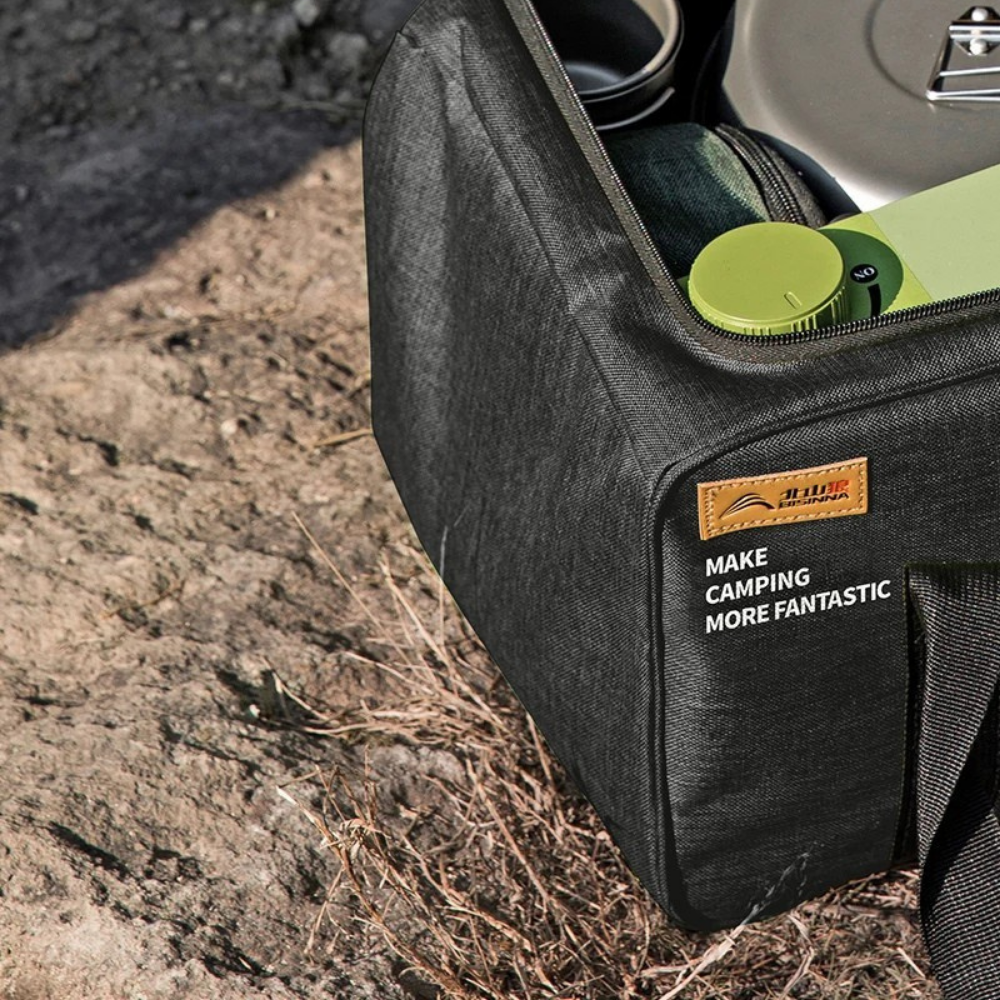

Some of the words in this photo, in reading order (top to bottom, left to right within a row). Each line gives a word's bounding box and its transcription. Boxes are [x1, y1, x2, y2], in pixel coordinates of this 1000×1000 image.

[705, 547, 768, 577] MAKE
[705, 567, 811, 605] CAMPING
[705, 603, 770, 634] MORE
[774, 579, 892, 621] FANTASTIC
